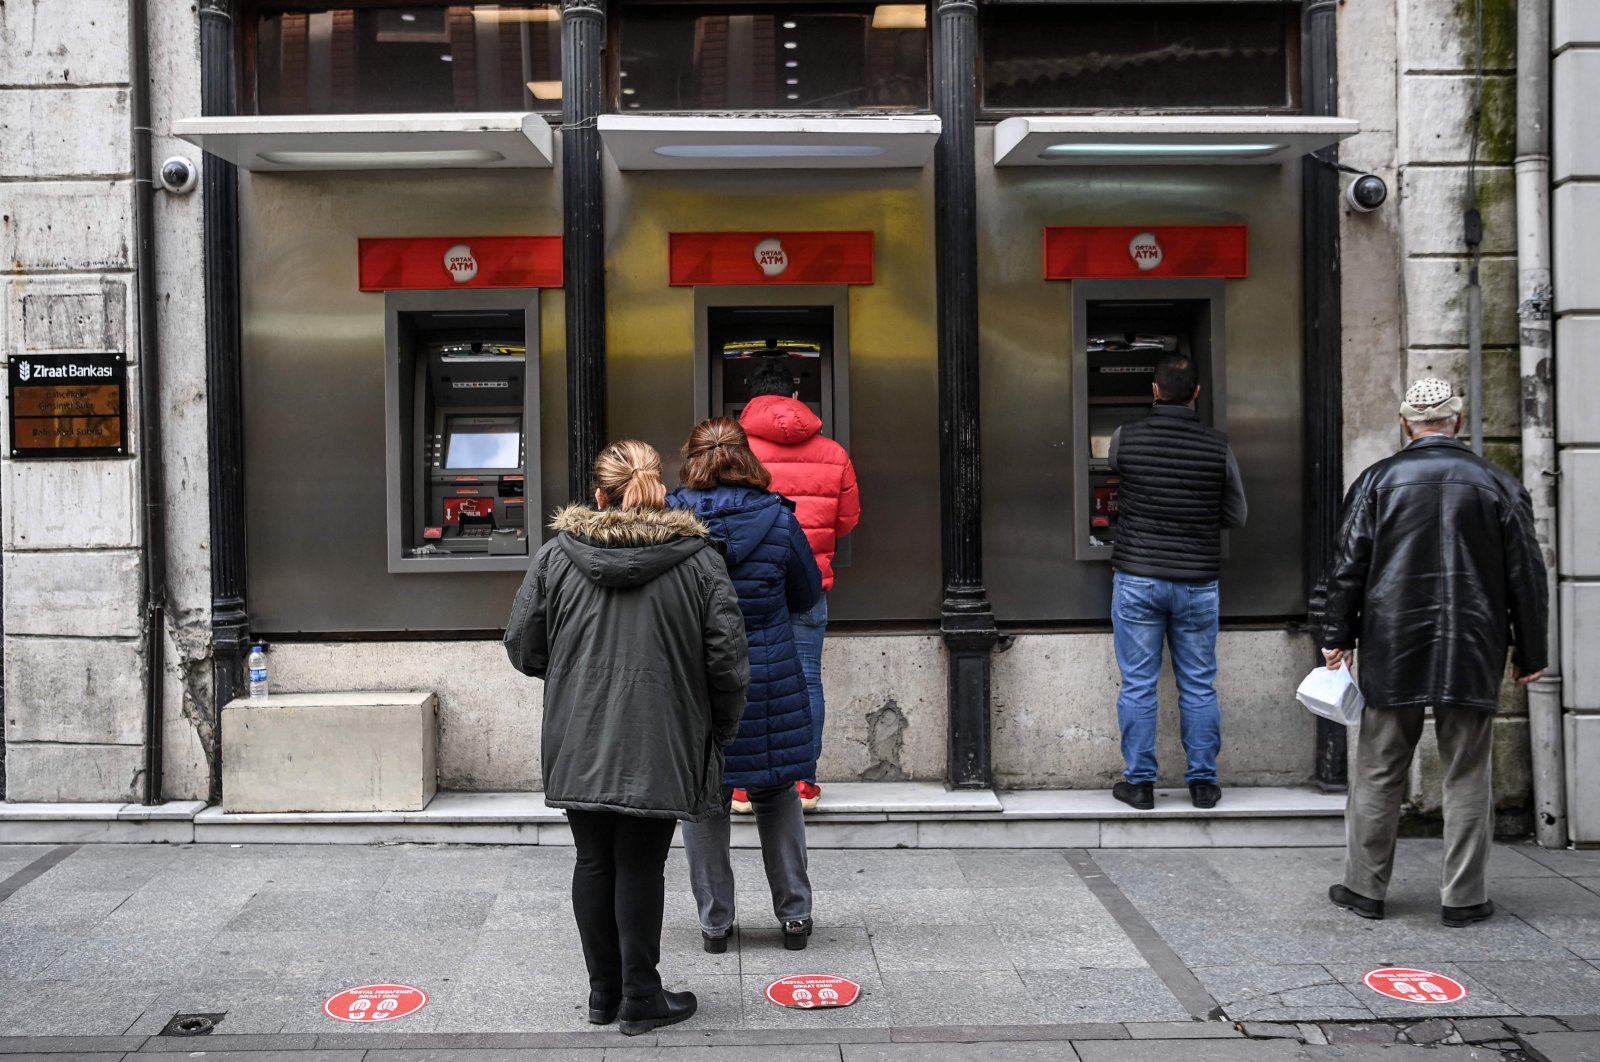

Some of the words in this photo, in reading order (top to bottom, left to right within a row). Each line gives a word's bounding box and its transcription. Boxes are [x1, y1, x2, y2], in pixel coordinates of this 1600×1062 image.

[1135, 250, 1158, 259] ATM
[760, 256, 784, 265] ATM
[450, 262, 474, 271] ATM
[33, 364, 68, 378] Ziraat
[68, 364, 113, 377] Bankası
